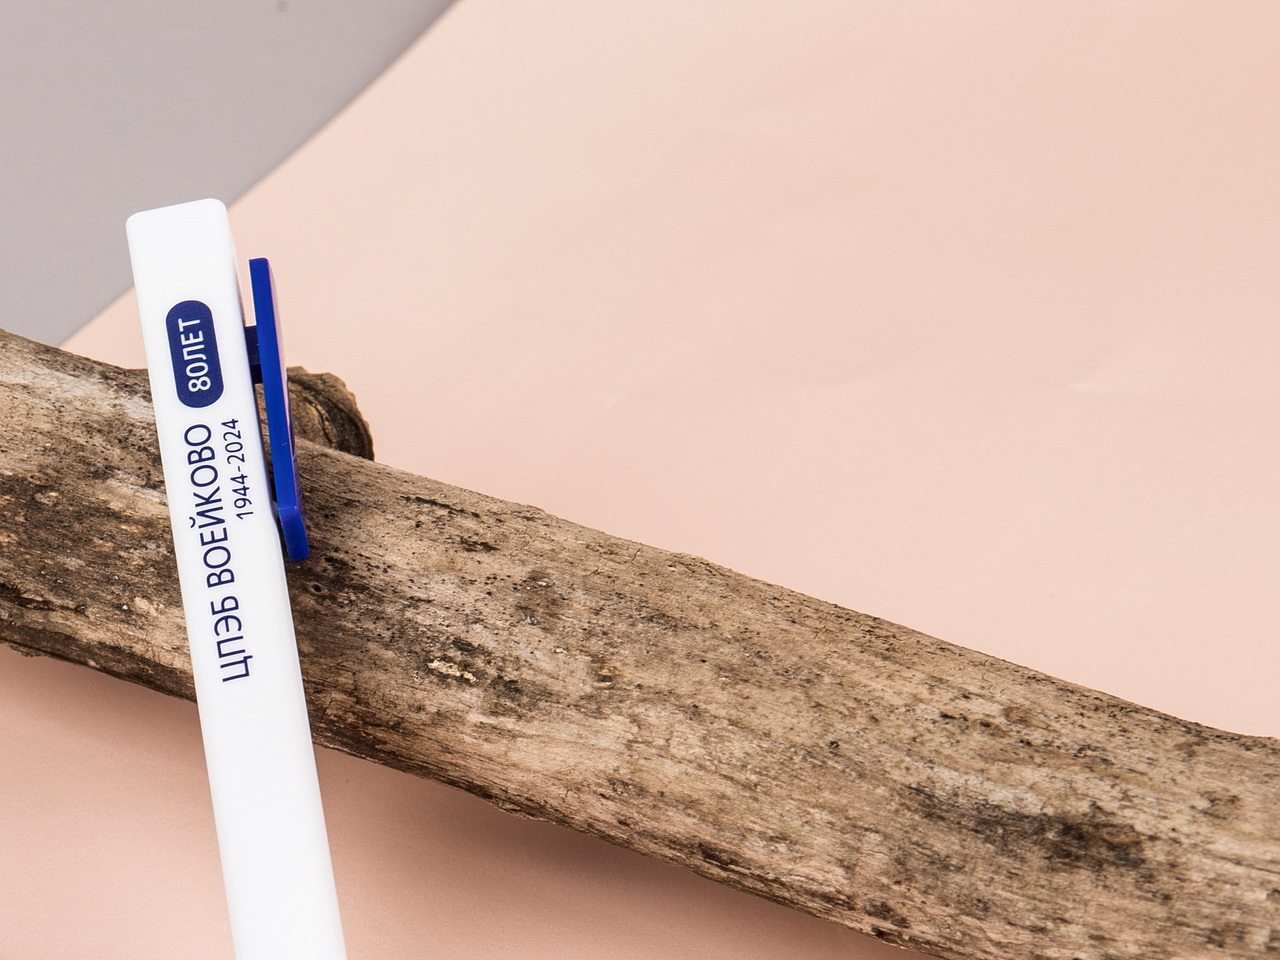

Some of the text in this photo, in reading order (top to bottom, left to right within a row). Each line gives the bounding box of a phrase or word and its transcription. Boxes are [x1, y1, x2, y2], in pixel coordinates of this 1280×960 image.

[178, 317, 211, 392] 80ЛЕТ
[221, 418, 253, 519] 1944-2024
[184, 423, 253, 682] ЦПЭБ ВОЕЙКОВО
